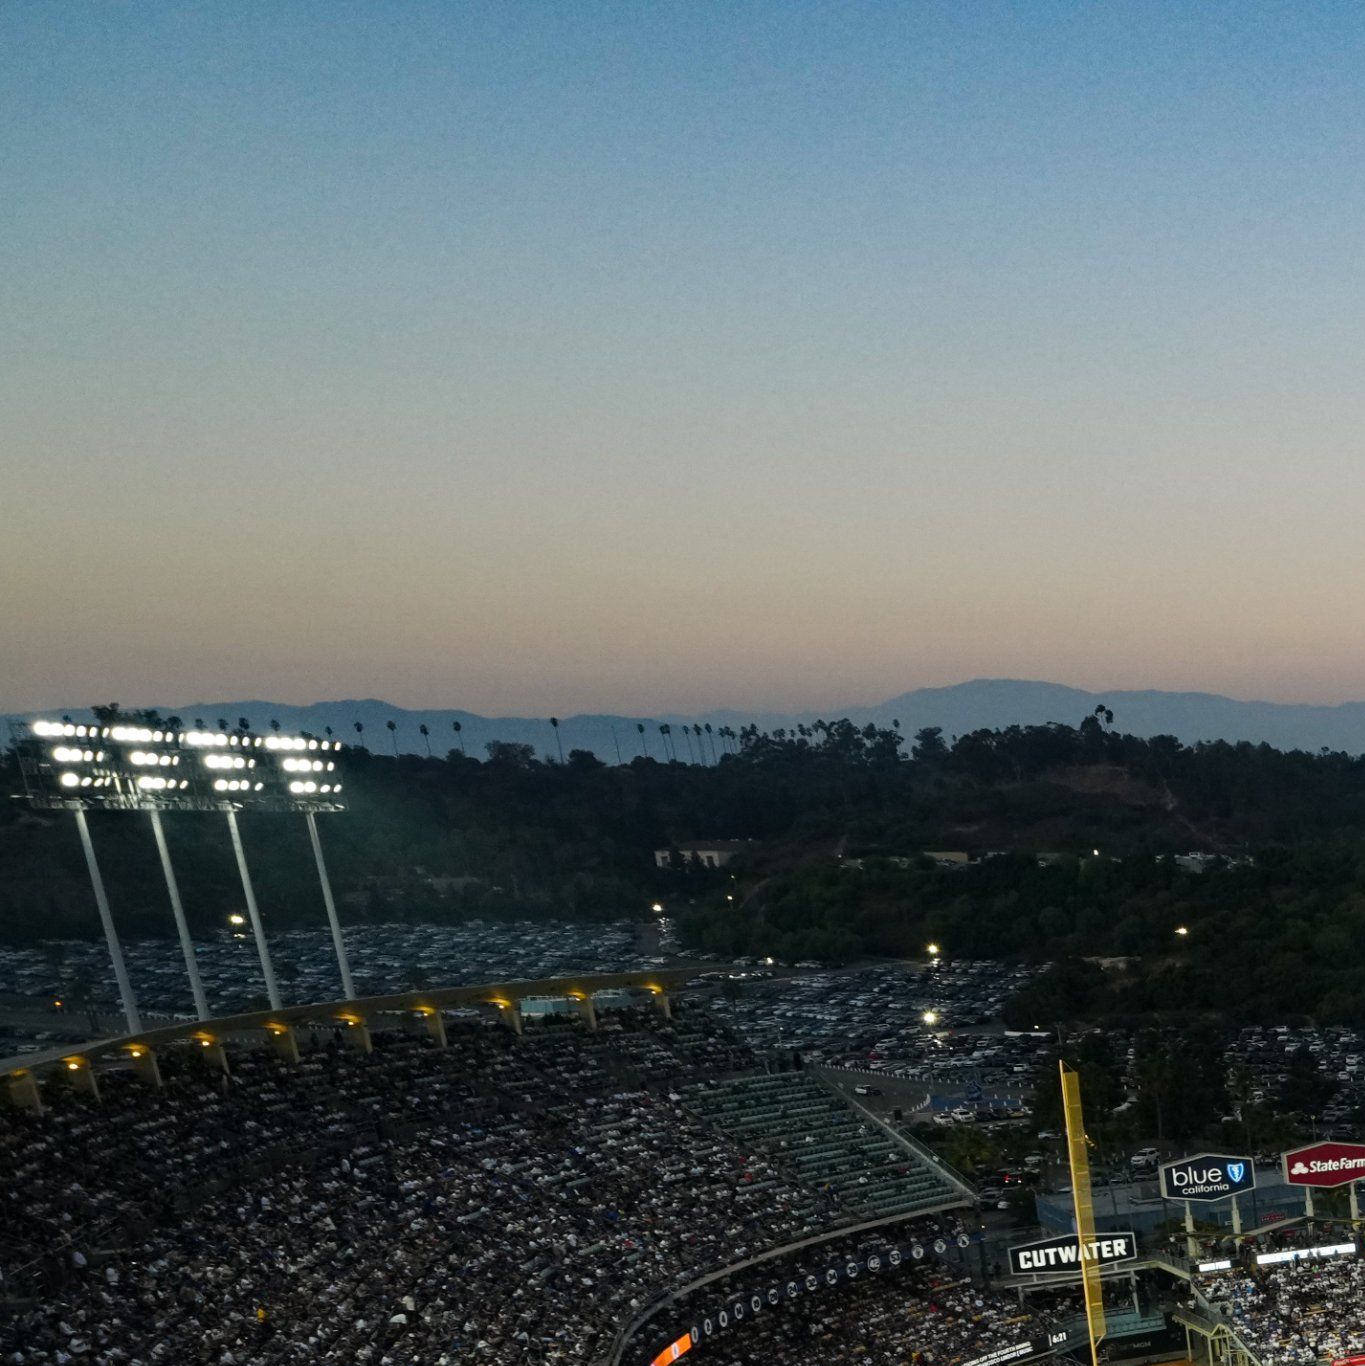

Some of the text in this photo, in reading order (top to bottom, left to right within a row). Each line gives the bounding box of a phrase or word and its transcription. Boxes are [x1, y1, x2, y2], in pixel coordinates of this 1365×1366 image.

[1172, 1166, 1223, 1187] blue
[1182, 1182, 1229, 1196] california
[1018, 1238, 1128, 1270] CUTWATER
[1052, 1332, 1067, 1343] 6:21
